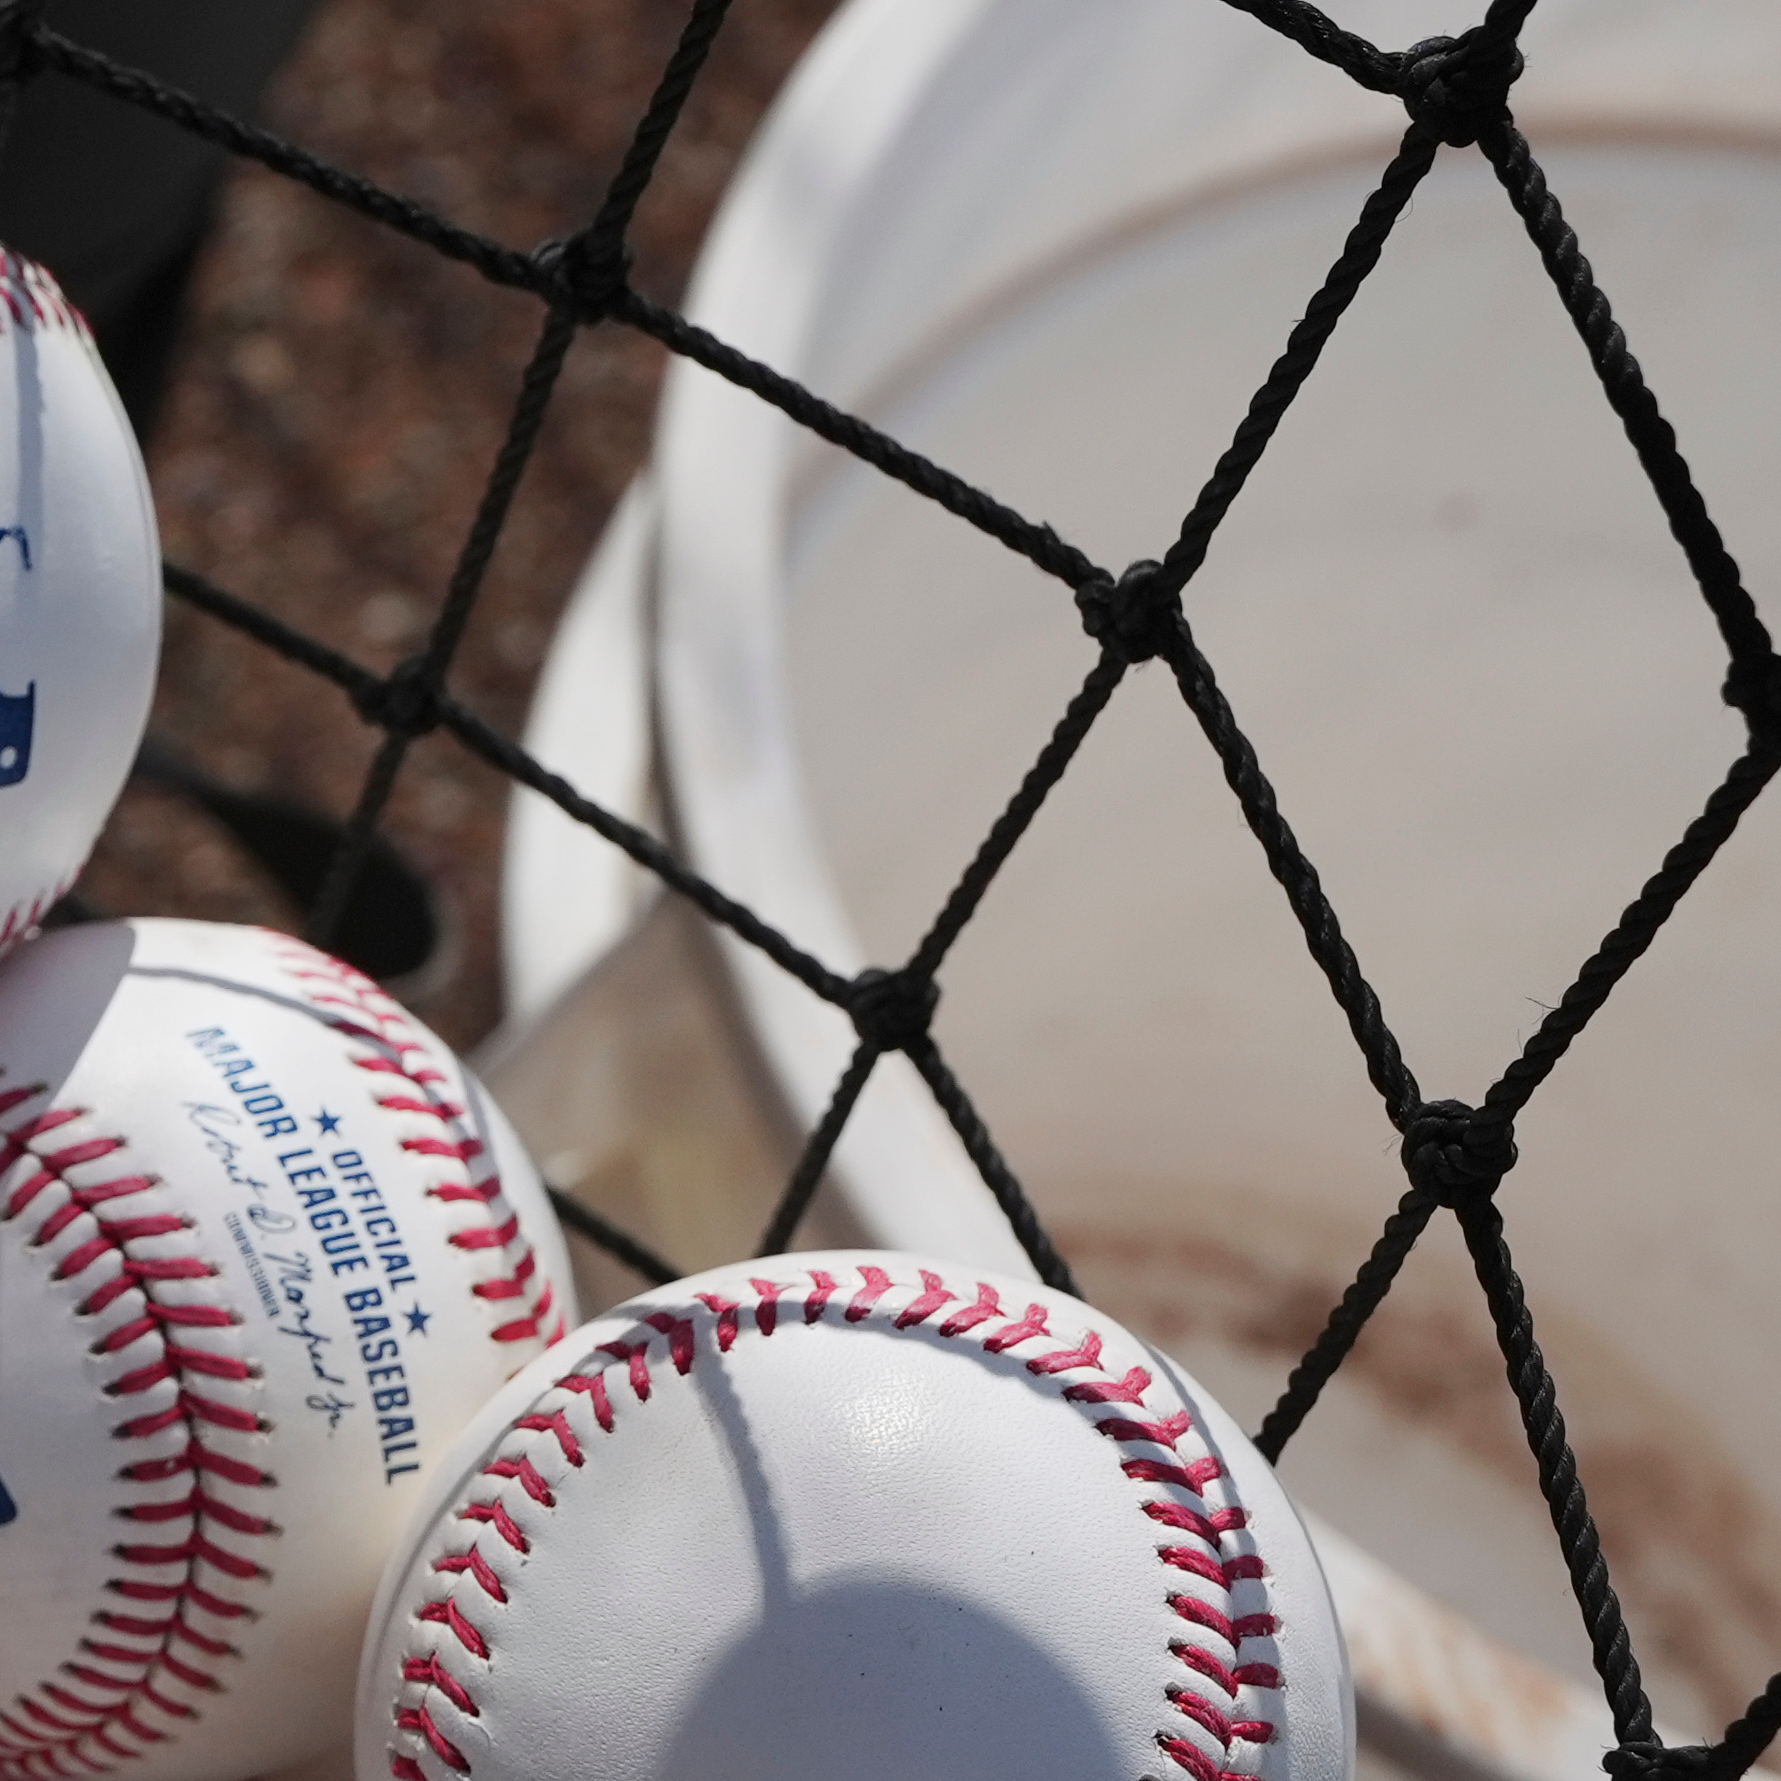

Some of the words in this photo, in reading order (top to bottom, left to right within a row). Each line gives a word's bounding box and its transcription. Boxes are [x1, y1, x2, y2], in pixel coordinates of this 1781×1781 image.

[185, 1026, 298, 1142] MAJOR
[277, 1148, 370, 1279] LEAGUE
[344, 1287, 423, 1486] BASEBALL
[331, 1149, 418, 1294] OFFICIAL
